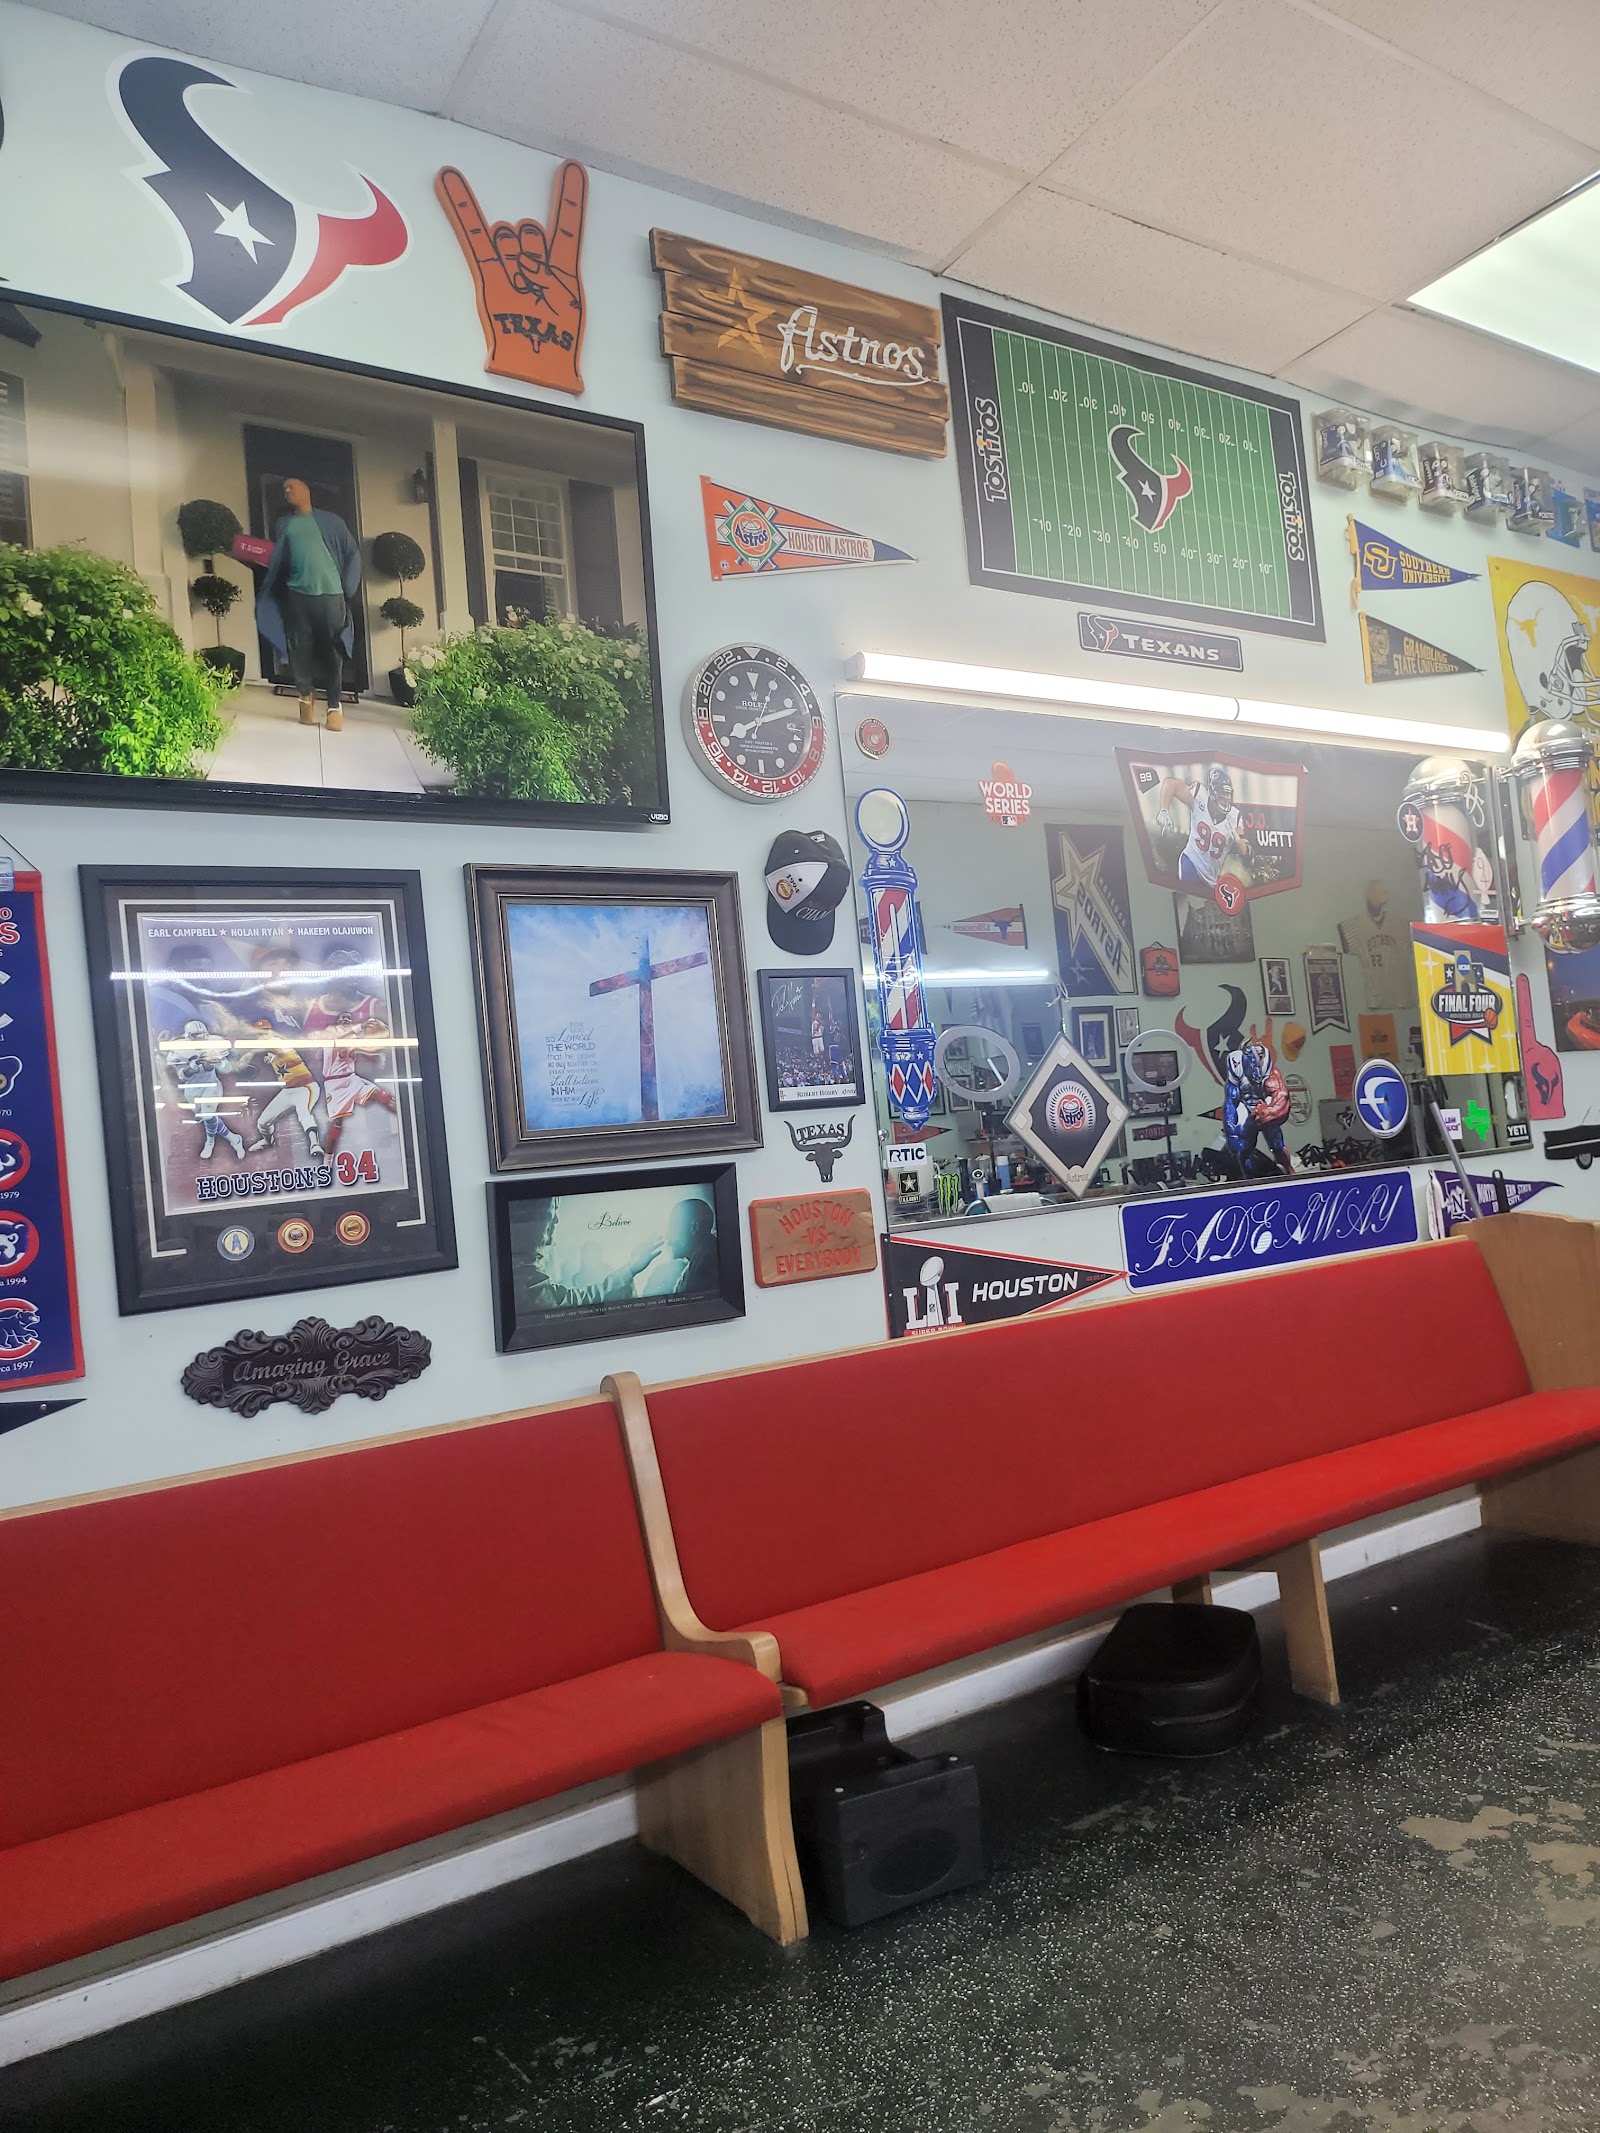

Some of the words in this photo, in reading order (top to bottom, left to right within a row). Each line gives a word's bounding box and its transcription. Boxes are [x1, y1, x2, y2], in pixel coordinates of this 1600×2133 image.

[493, 313, 573, 351] TEXAS
[777, 305, 929, 383] Astros
[734, 522, 769, 547] Astros
[787, 531, 832, 554] HOUSTON
[1399, 551, 1451, 575] SOUTHERN
[1121, 633, 1220, 661] TEXANS
[1404, 637, 1448, 663] GRAMBLING
[713, 650, 737, 671] 22
[775, 657, 789, 672] 2
[1393, 653, 1417, 675] STATE
[1417, 657, 1459, 674] UNIVERSITY
[698, 672, 714, 696] 20
[799, 682, 811, 697] 4
[697, 706, 710, 728] 18
[812, 715, 822, 729] 6
[707, 741, 724, 763] 16
[808, 748, 820, 762] 8
[732, 768, 750, 787] 14
[788, 771, 806, 787] 10
[1139, 771, 1153, 782] 99
[761, 780, 780, 793] 12
[979, 781, 1032, 799] WORLD
[985, 797, 1031, 815] SERIES
[651, 813, 669, 821] VIZIO
[1195, 820, 1227, 859] 99
[1256, 830, 1293, 848] WATT
[786, 874, 800, 893] 1994
[148, 929, 171, 938] EARL
[173, 928, 218, 937] CAMPBELL
[231, 928, 260, 937] NOLAN
[261, 928, 284, 937] RYAN
[297, 927, 330, 936] HAKEEM
[332, 926, 374, 936] OLAJUWON
[1438, 994, 1468, 1012] FINAL
[1469, 994, 1496, 1012] FOUR
[546, 1043, 564, 1052] THE
[564, 1042, 596, 1051] WORLD
[547, 1052, 562, 1061] that
[565, 1052, 574, 1060] he
[577, 1053, 597, 1061] gave
[560, 1086, 576, 1096] HIM
[578, 1088, 605, 1110] Life
[1059, 1107, 1084, 1125] Astros
[796, 1123, 845, 1140] TEXAS
[1507, 1124, 1527, 1137] YETI
[889, 1147, 925, 1163] RTIC
[195, 1165, 332, 1200] HOUSTON'S
[337, 1149, 380, 1186] 34
[0, 1191, 20, 1200] 1979
[588, 1212, 632, 1230] Believe
[778, 1200, 855, 1237] HOUSTON
[775, 1246, 862, 1277] EVERYBODY
[6, 1276, 28, 1286] 1994
[972, 1271, 1079, 1303] HOUSTON
[13, 1361, 34, 1371] 1997
[232, 1358, 328, 1383] Amazing
[333, 1350, 392, 1376] Grace
